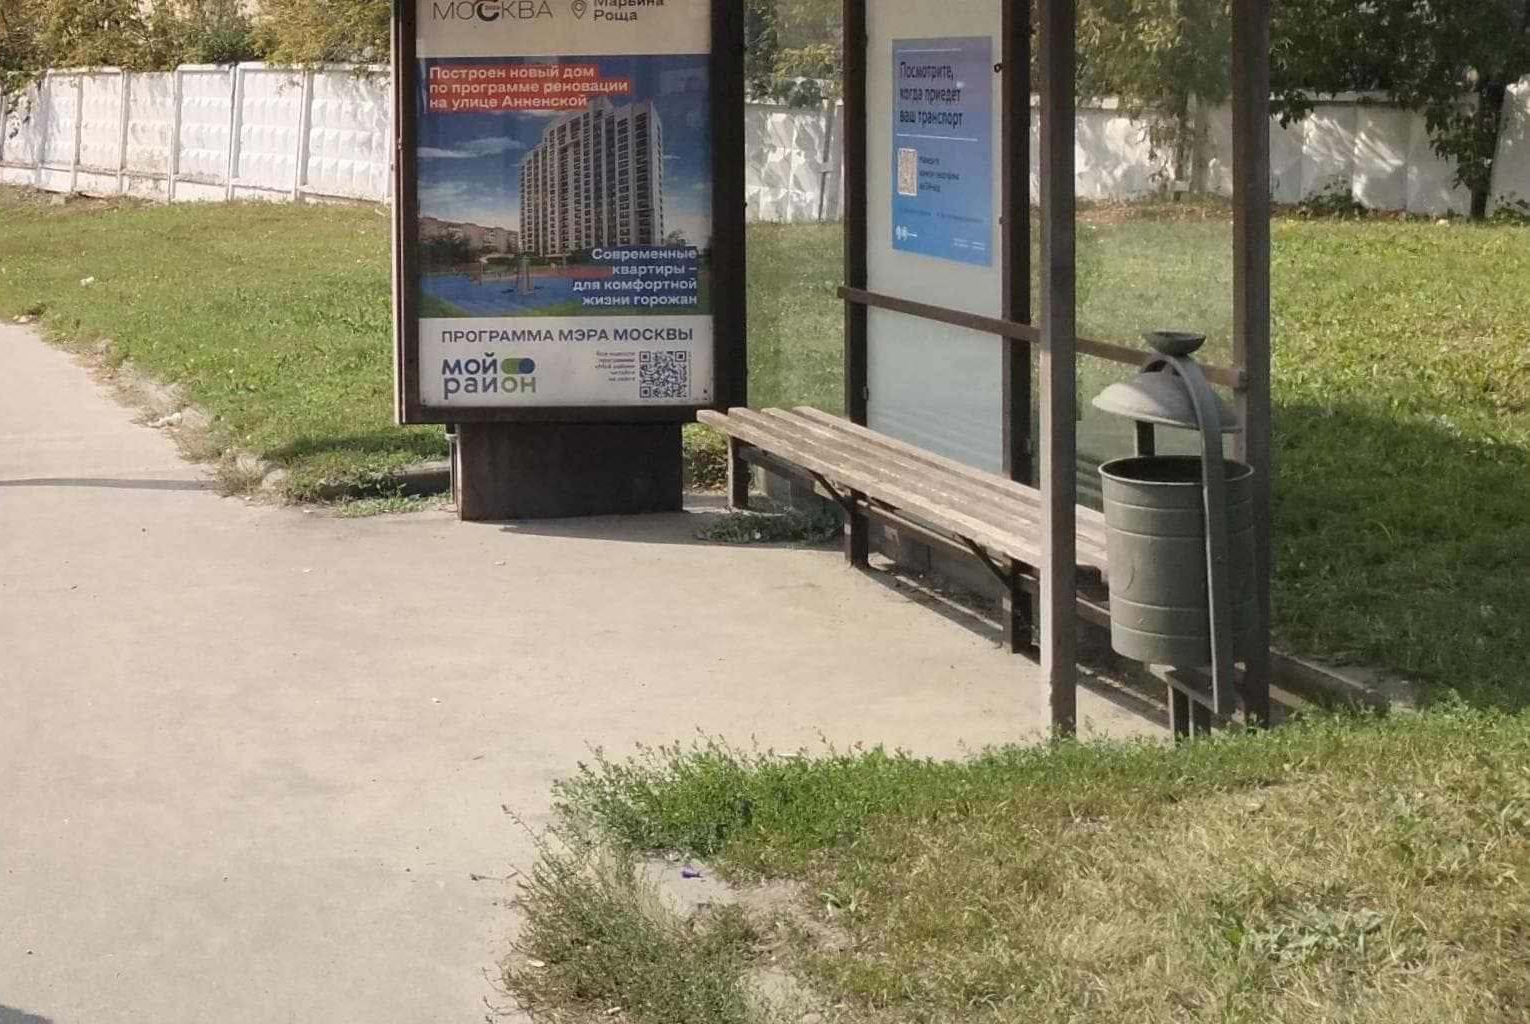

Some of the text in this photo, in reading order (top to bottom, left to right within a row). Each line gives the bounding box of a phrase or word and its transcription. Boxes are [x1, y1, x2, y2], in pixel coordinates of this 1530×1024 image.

[594, 9, 638, 22] Роща
[430, 64, 594, 81] Построен новый дом
[430, 80, 628, 97] по программе реновации
[900, 88, 961, 105] когда приедет
[430, 94, 587, 112] на улице Анненской
[918, 111, 963, 130] транспорт
[592, 248, 697, 263] Современные
[612, 264, 685, 277] квартиры
[573, 278, 697, 294] для комфортной
[582, 295, 697, 307] жизни горожан
[442, 328, 693, 343] ПРОГРАММА МЭРА МОСКВЫ
[442, 352, 497, 375] мой
